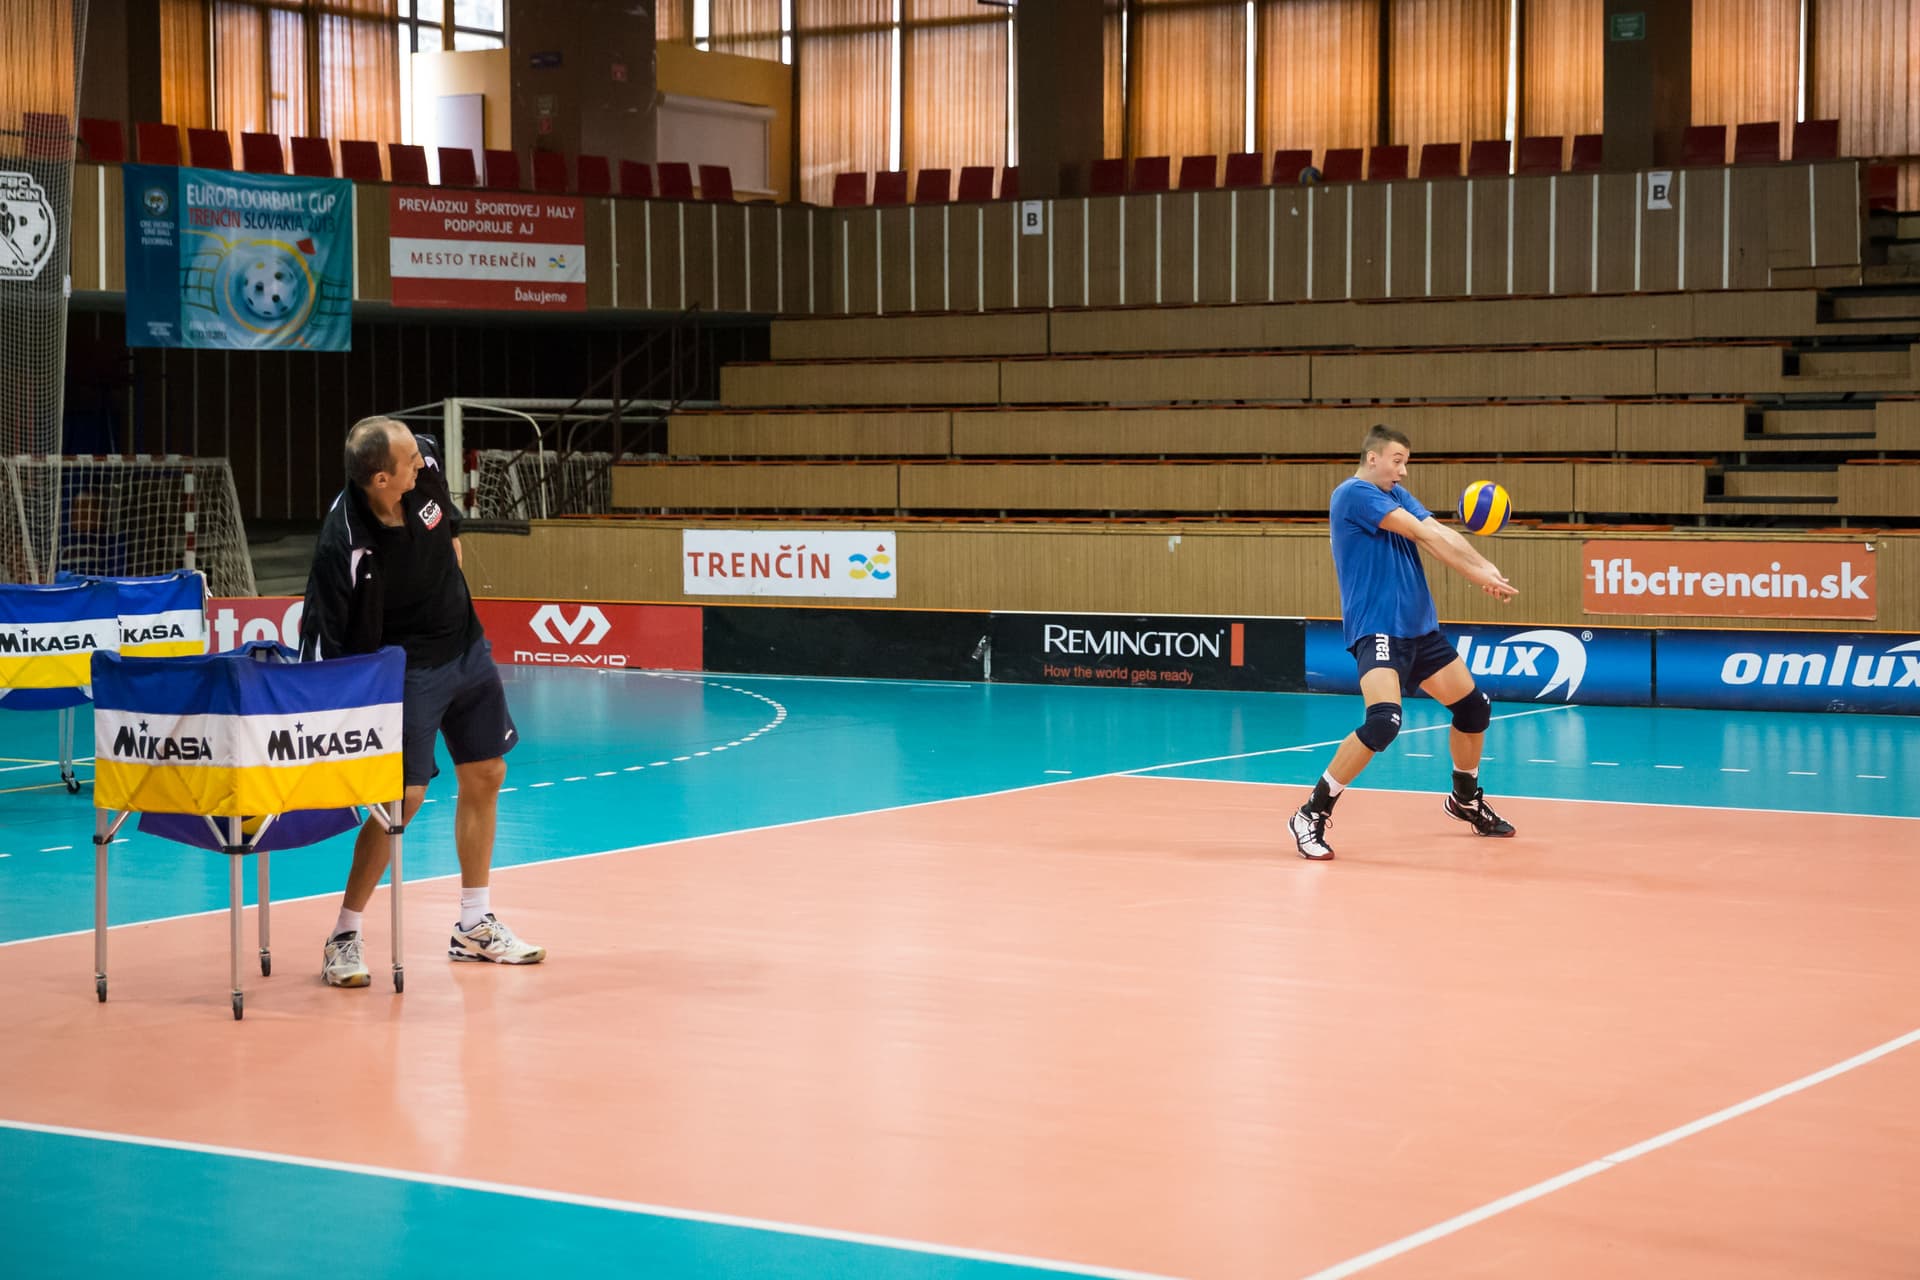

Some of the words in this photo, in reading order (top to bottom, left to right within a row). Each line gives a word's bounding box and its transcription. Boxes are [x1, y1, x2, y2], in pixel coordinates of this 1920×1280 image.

[186, 183, 305, 212] EUROFLOORBALL
[308, 191, 336, 214] CUP
[1653, 185, 1666, 200] B
[399, 197, 468, 214] PREVÁDZKU
[475, 198, 541, 218] ŠPORTOVEJ
[546, 206, 576, 219] HALY
[244, 211, 304, 232] SLOVAKIA
[444, 218, 513, 234] PODPORUJE
[519, 222, 535, 235] AJ
[1027, 212, 1038, 227] B
[411, 251, 464, 266] MESTO
[469, 252, 537, 268] TRENČÍN
[514, 287, 568, 304] Ďakujeme
[687, 544, 831, 579] TRENČÍN
[1588, 558, 1870, 599] 1fbctrencin.sk
[1044, 624, 1221, 658] REMINGTON
[1044, 664, 1071, 679] How
[1073, 666, 1093, 679] the
[1095, 667, 1129, 681] world
[1131, 668, 1158, 684] gets
[1160, 669, 1194, 685] ready
[1720, 645, 1920, 688] omlux
[113, 719, 214, 761] MIKASA
[267, 720, 384, 761] MIKASA
